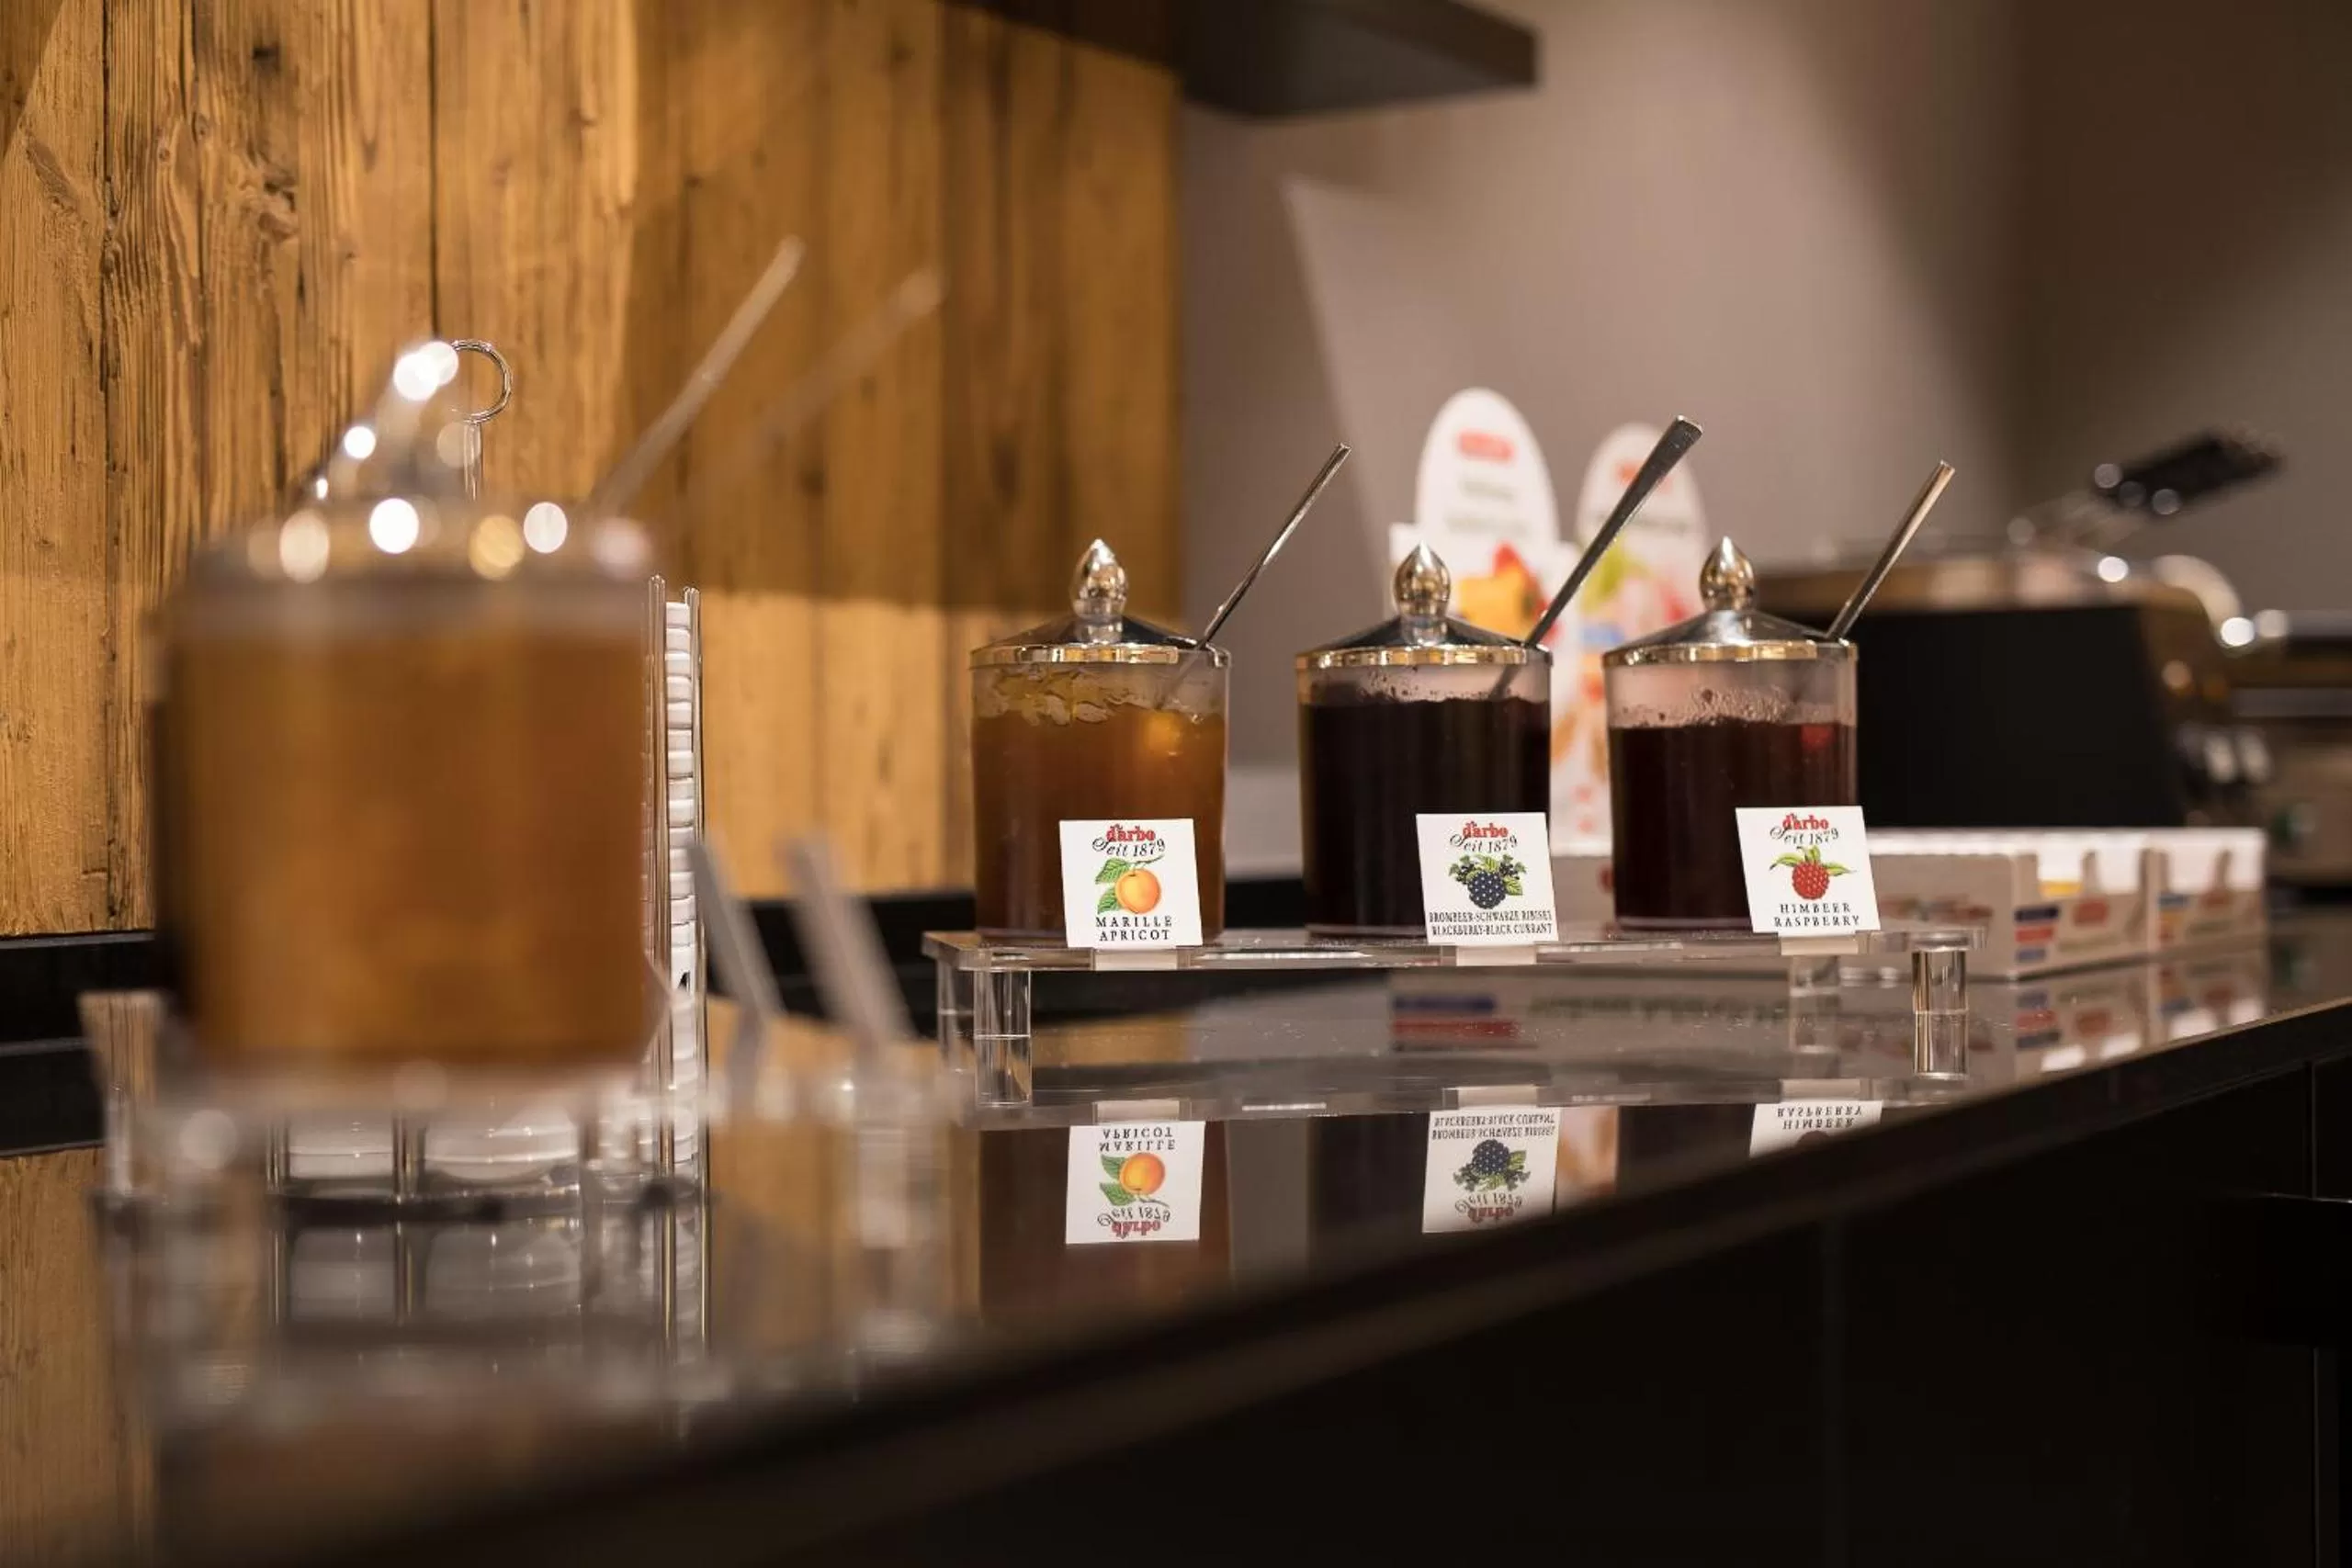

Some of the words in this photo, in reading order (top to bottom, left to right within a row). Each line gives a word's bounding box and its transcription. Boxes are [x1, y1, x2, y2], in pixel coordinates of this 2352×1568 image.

[1769, 826, 1804, 844] Seit
[1809, 828, 1839, 844] 1879
[1091, 837, 1128, 857] Seit
[1132, 838, 1166, 857] 1879
[1449, 833, 1483, 852] Seit
[1487, 835, 1519, 853] 1879
[1780, 903, 1851, 914] HIMBEER
[1095, 916, 1172, 928] MARILLE
[1774, 915, 1860, 928] RASPBERRY
[1099, 930, 1171, 942] APRICOT
